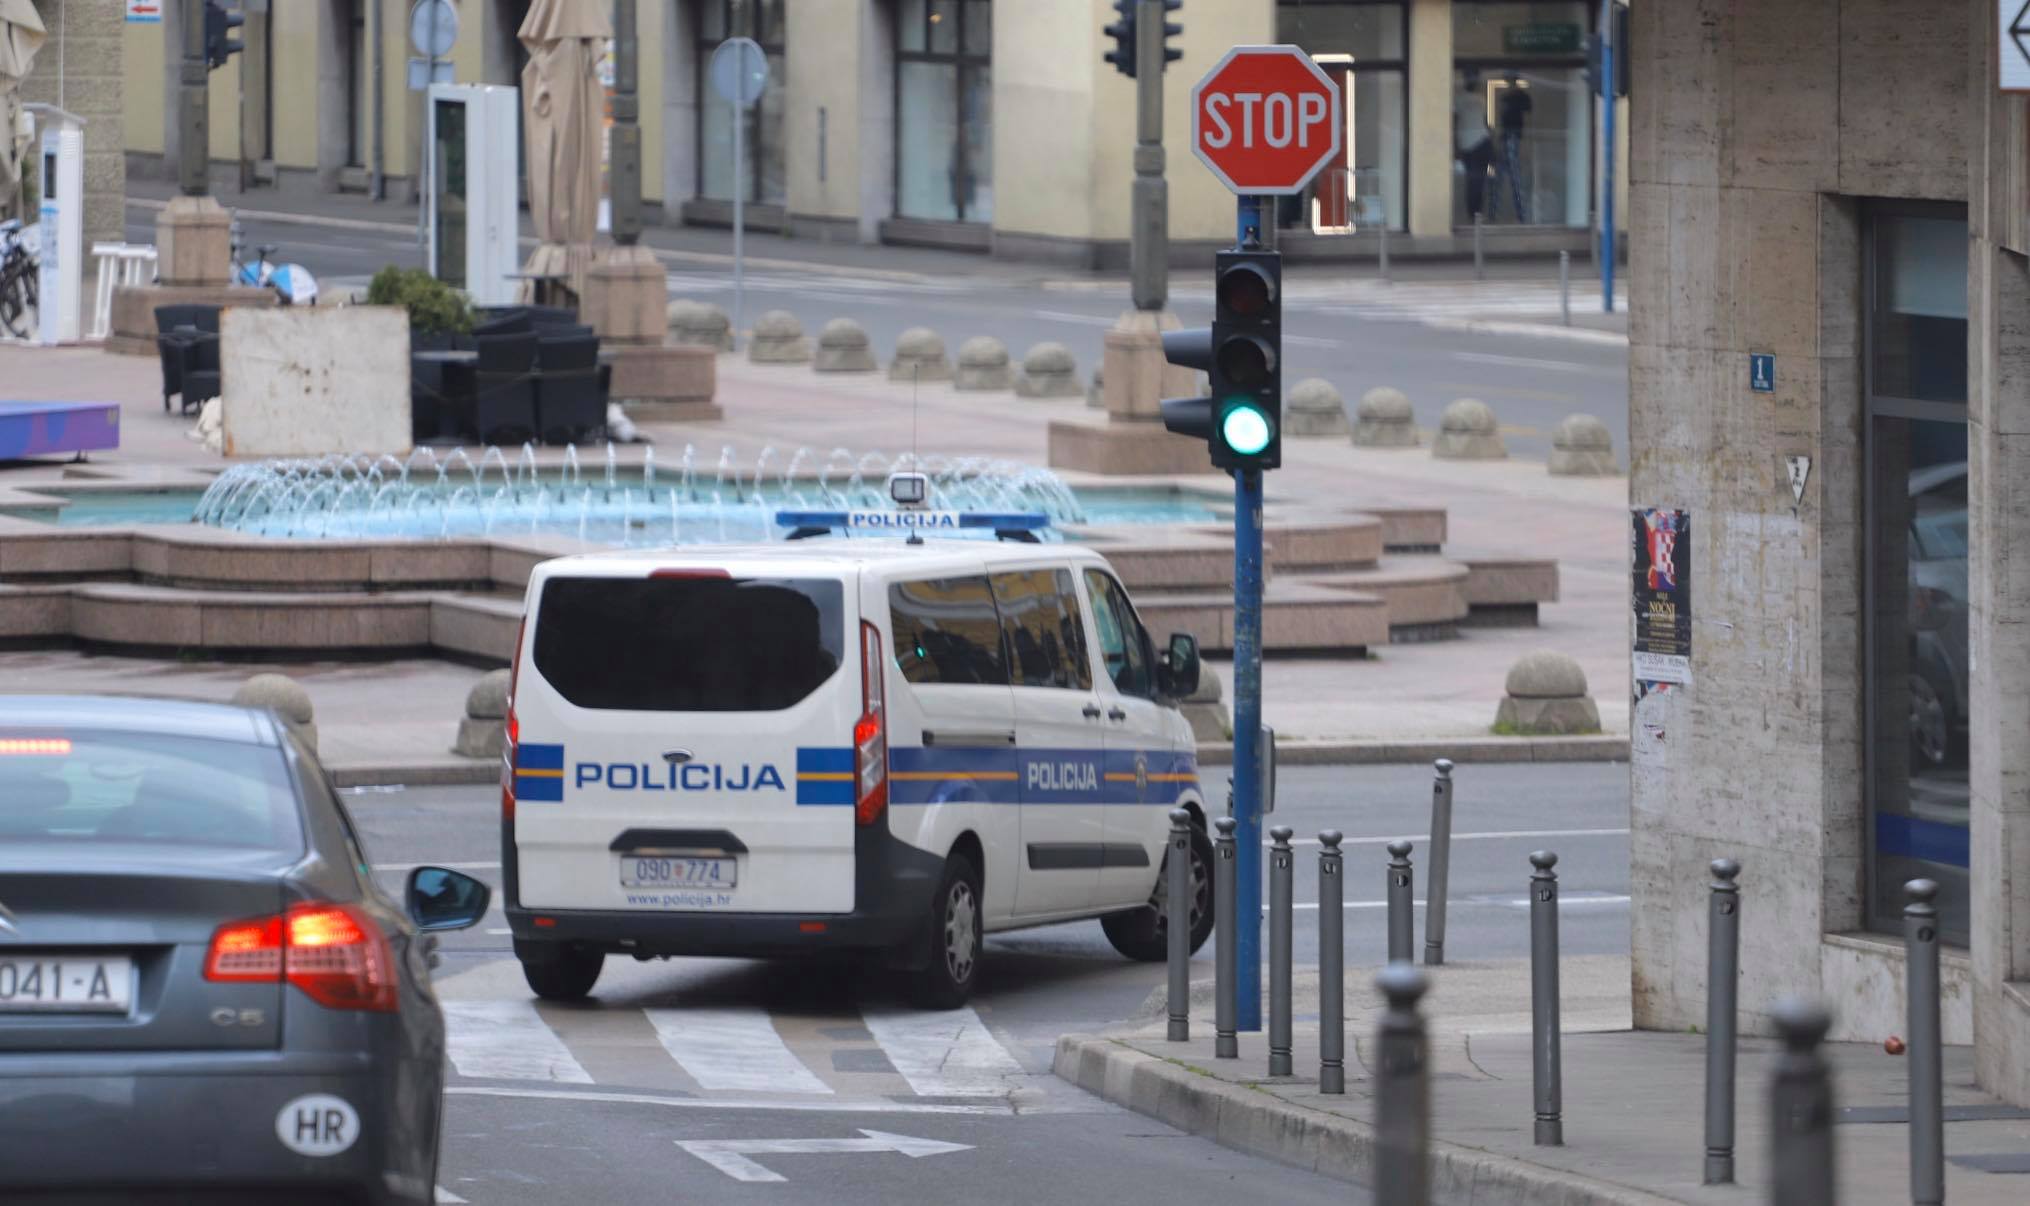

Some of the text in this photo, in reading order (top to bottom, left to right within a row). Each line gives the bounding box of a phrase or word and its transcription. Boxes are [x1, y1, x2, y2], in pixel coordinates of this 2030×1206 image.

[1204, 92, 1327, 149] STOP
[1756, 357, 1765, 381] 1
[853, 512, 954, 527] POLICIJA
[576, 762, 786, 791] POLICIJA
[1027, 761, 1098, 791] POLICIJA
[636, 860, 720, 880] 090 774
[627, 893, 731, 908] www.policija.hr
[210, 1006, 265, 1026] C5
[297, 1109, 344, 1142] HR
